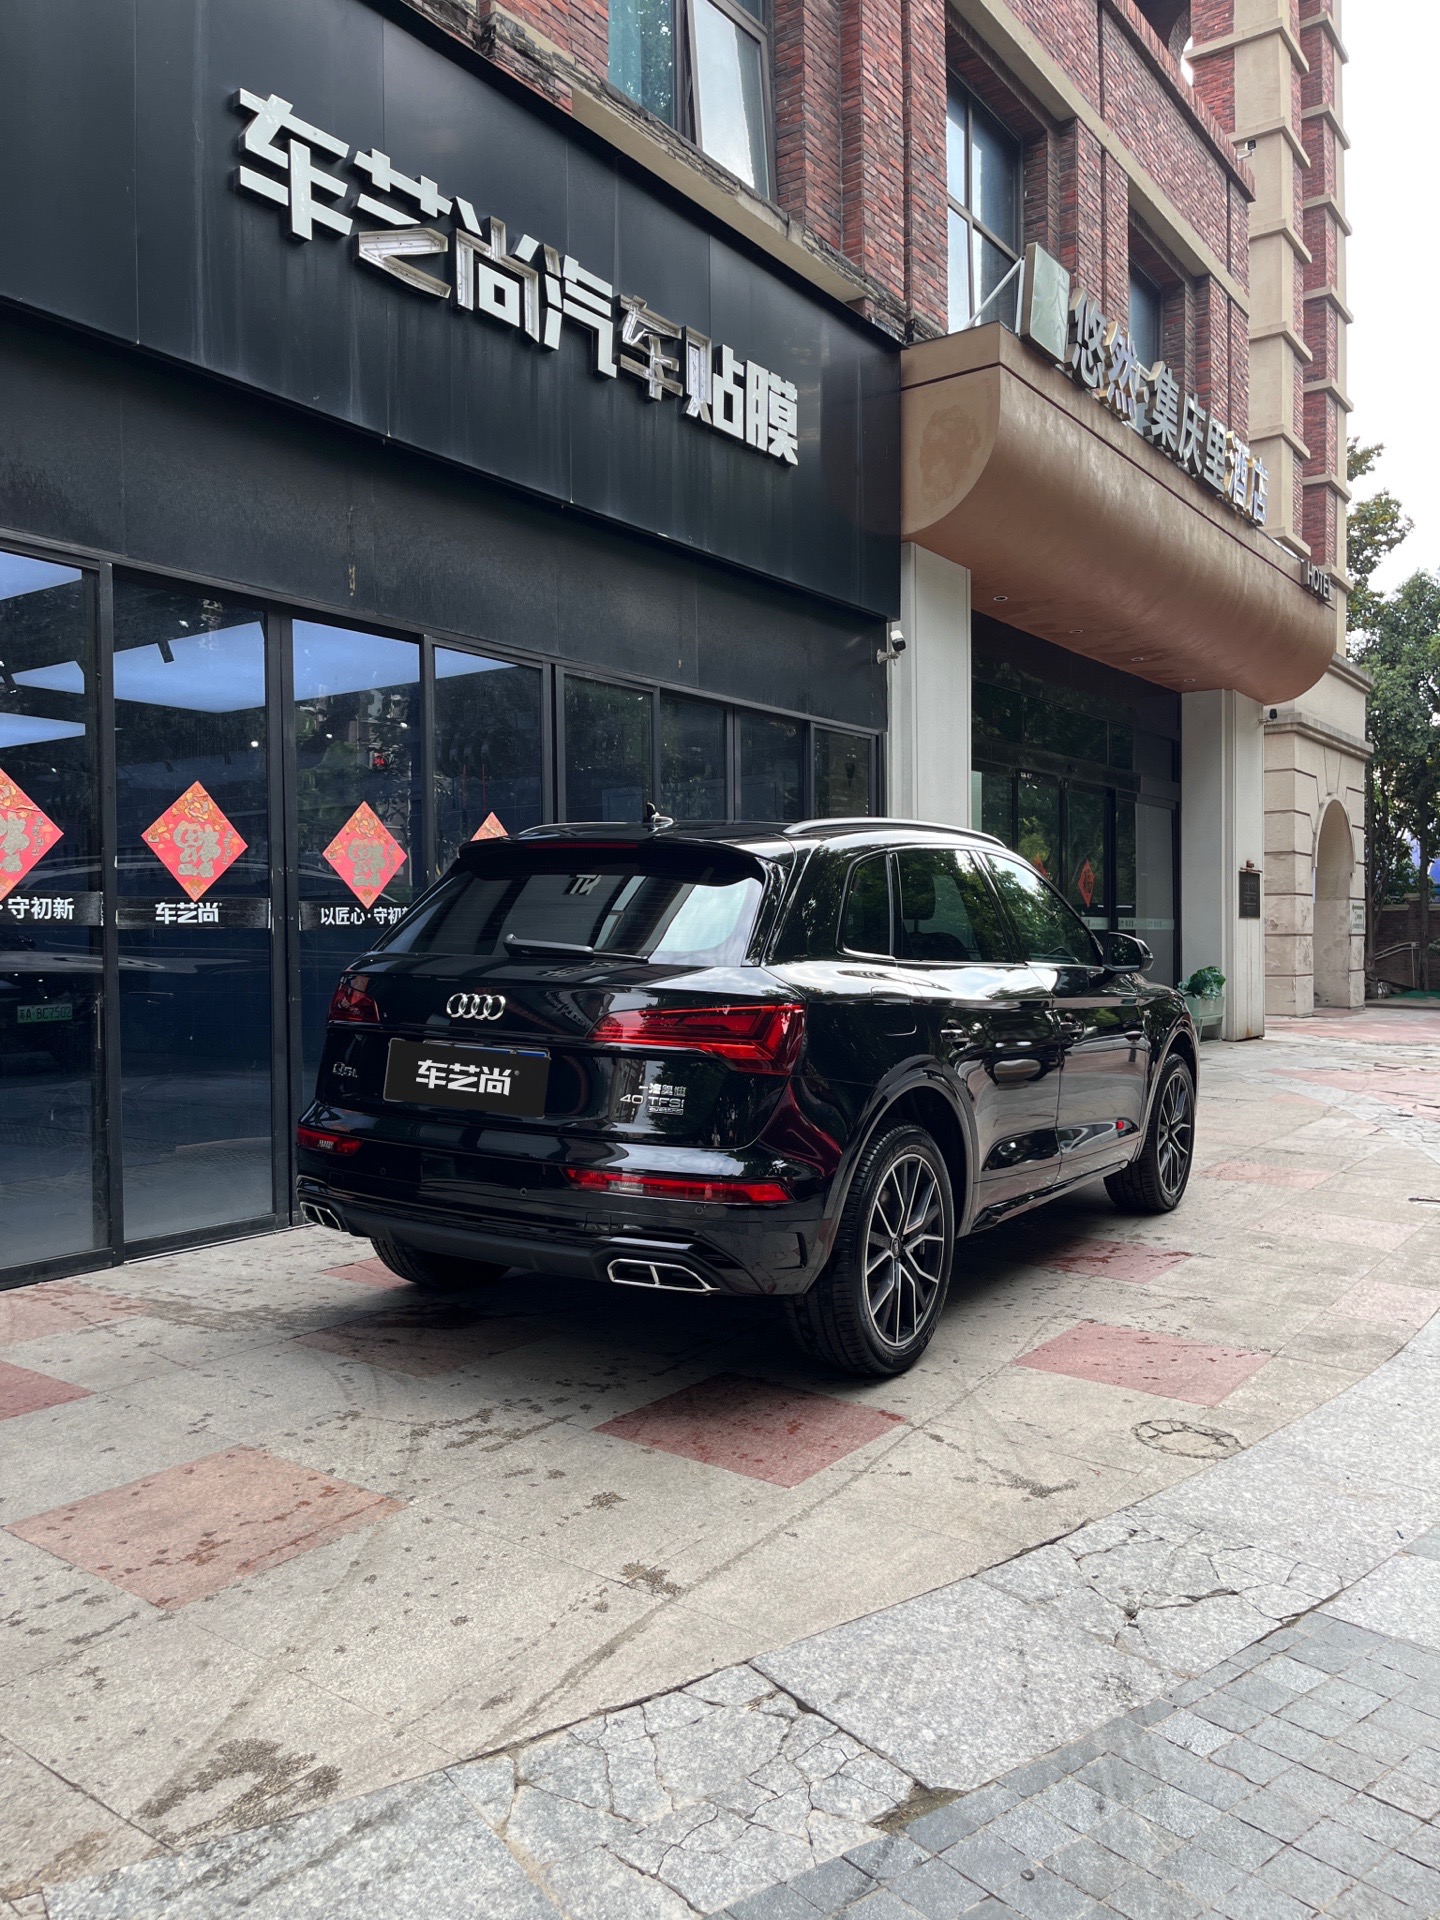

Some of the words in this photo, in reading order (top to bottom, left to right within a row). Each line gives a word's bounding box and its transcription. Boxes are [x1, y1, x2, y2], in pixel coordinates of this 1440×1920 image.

[239, 87, 799, 466] 车艺尚汽车贴膜
[155, 902, 219, 924] 车艺尚
[320, 906, 409, 925] 以匠心·守初
[620, 1094, 644, 1105] 40
